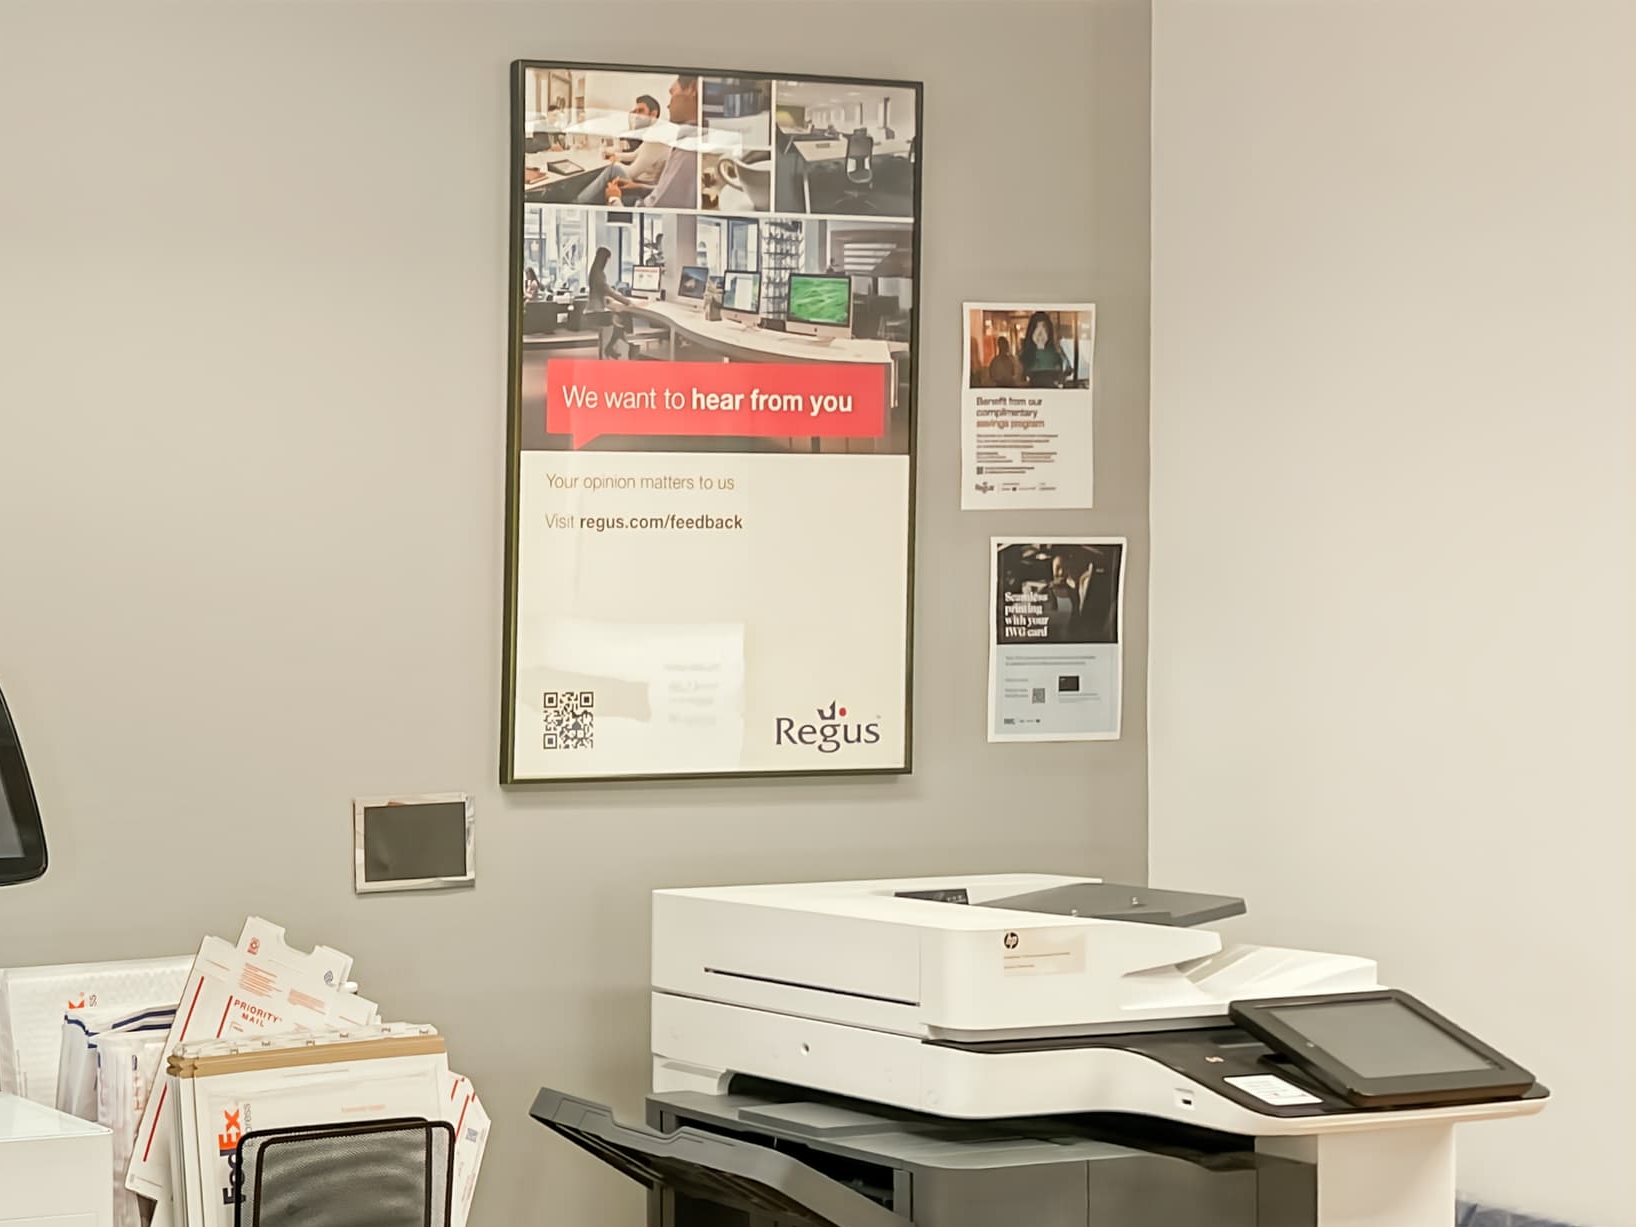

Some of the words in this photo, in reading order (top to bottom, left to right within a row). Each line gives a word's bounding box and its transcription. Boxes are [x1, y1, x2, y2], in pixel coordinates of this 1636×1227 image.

[562, 385, 598, 409] We
[604, 387, 657, 410] want
[664, 388, 685, 410] to
[691, 387, 745, 411] hear
[750, 388, 803, 412] from
[809, 395, 853, 417] you
[546, 472, 579, 489] Your
[583, 474, 636, 492] opinion
[640, 475, 695, 490] matters
[699, 475, 714, 490] to
[718, 477, 735, 490] us
[545, 512, 575, 529] Visit
[579, 513, 744, 533] regus.com/feedback
[1004, 614, 1027, 625] with
[775, 716, 881, 753] Regus
[234, 999, 280, 1023] PRIORITY
[241, 1012, 265, 1028] MAIL
